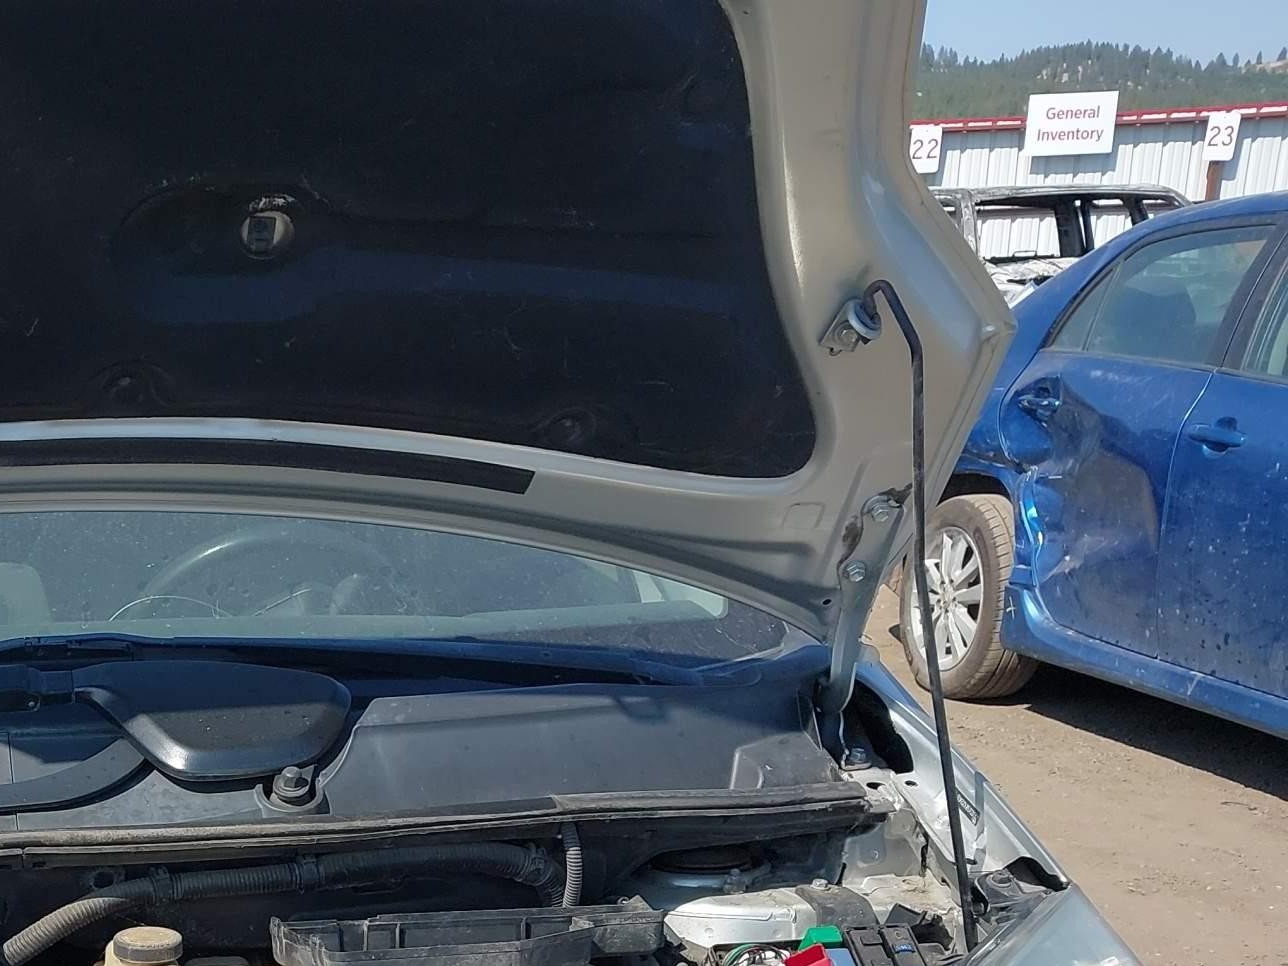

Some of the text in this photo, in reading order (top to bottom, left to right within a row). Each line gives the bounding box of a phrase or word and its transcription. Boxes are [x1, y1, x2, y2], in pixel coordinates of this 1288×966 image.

[1045, 105, 1101, 120] General
[1037, 128, 1104, 142] Inventory
[1208, 126, 1234, 147] 23
[912, 138, 939, 160] 22
